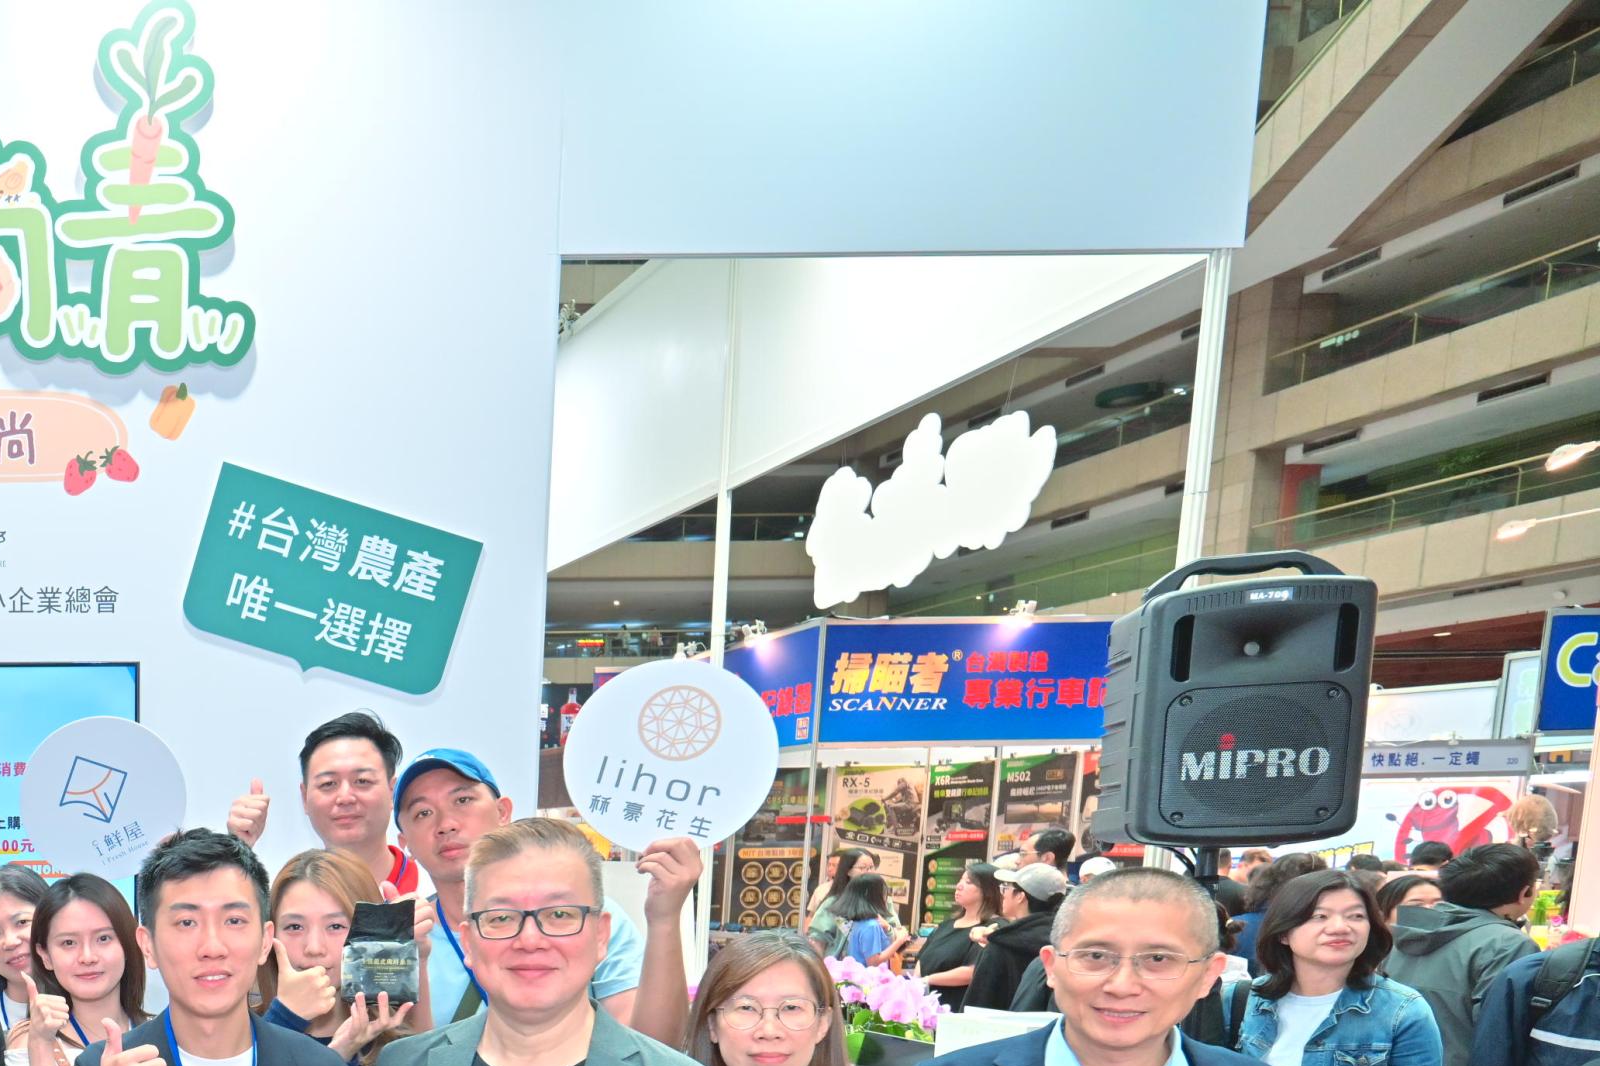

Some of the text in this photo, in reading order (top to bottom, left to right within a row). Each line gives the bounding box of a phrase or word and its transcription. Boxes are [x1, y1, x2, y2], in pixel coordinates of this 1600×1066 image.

[228, 501, 445, 601] #台灣農產
[225, 572, 413, 663] 唯一選擇
[829, 696, 948, 712] SCANNER
[597, 756, 721, 806] lihor
[1007, 771, 1031, 783] M502
